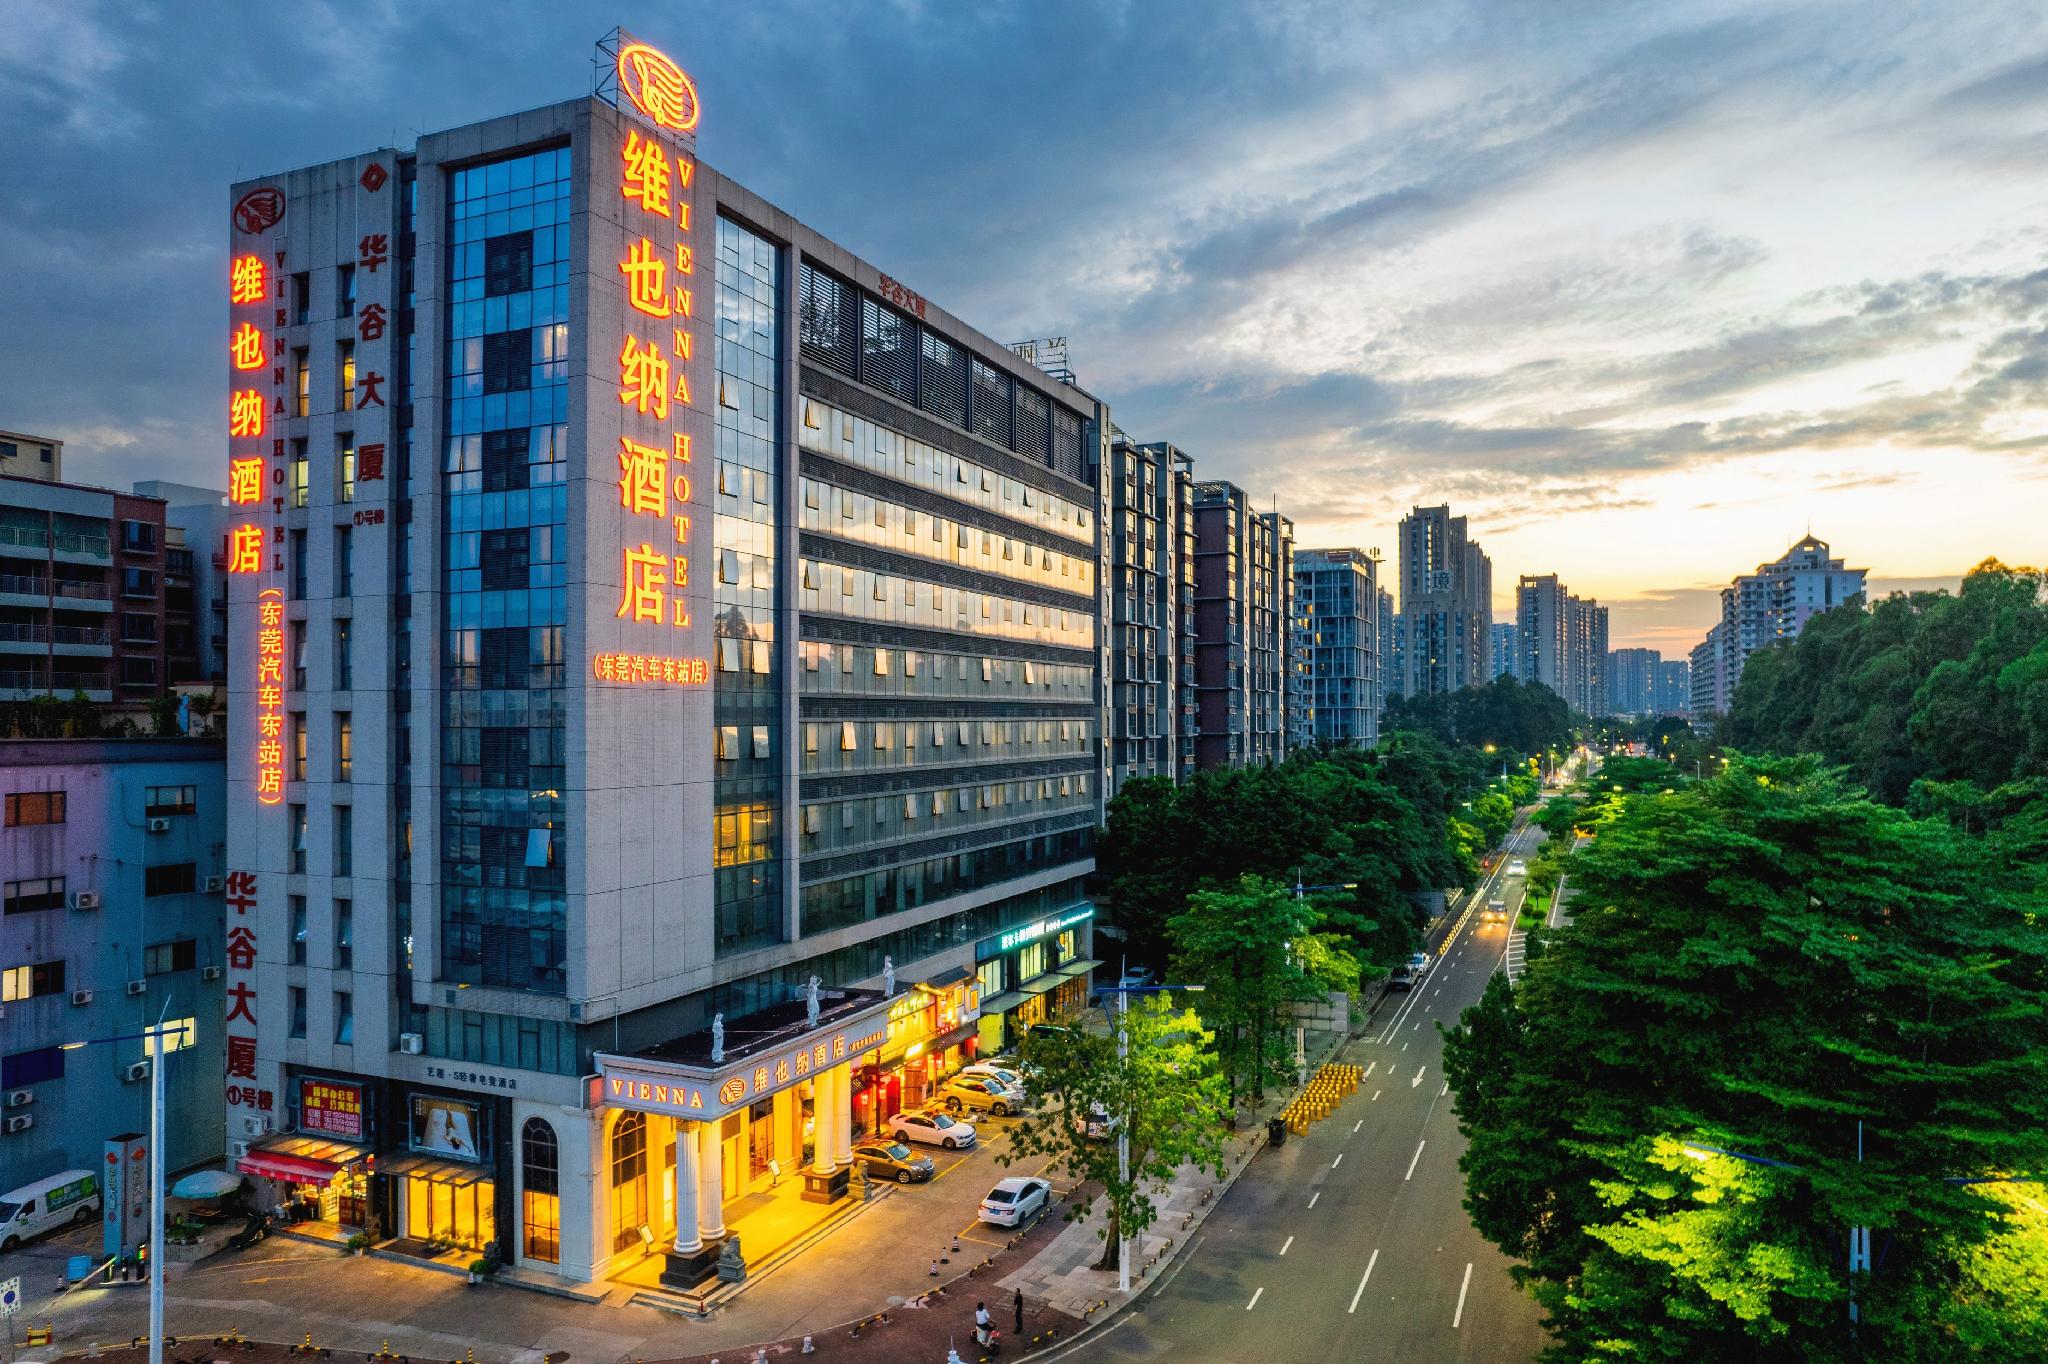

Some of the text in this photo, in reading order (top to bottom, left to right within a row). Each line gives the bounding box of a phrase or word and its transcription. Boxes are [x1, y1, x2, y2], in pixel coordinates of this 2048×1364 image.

[230, 256, 265, 574] 维也纳酒店
[273, 251, 286, 571] VIENNA HOTEL
[356, 233, 387, 482] 华谷大厦
[617, 129, 671, 625] 维也纳酒店
[673, 157, 693, 627] VIENNA HOTEL
[258, 589, 283, 804] (东莞汽车东站店)
[593, 653, 710, 684] (东莞汽车东站店)
[226, 871, 257, 1081] 华谷大厦
[754, 1035, 845, 1093] 维也纳酒店
[612, 1079, 704, 1109] VIENNA
